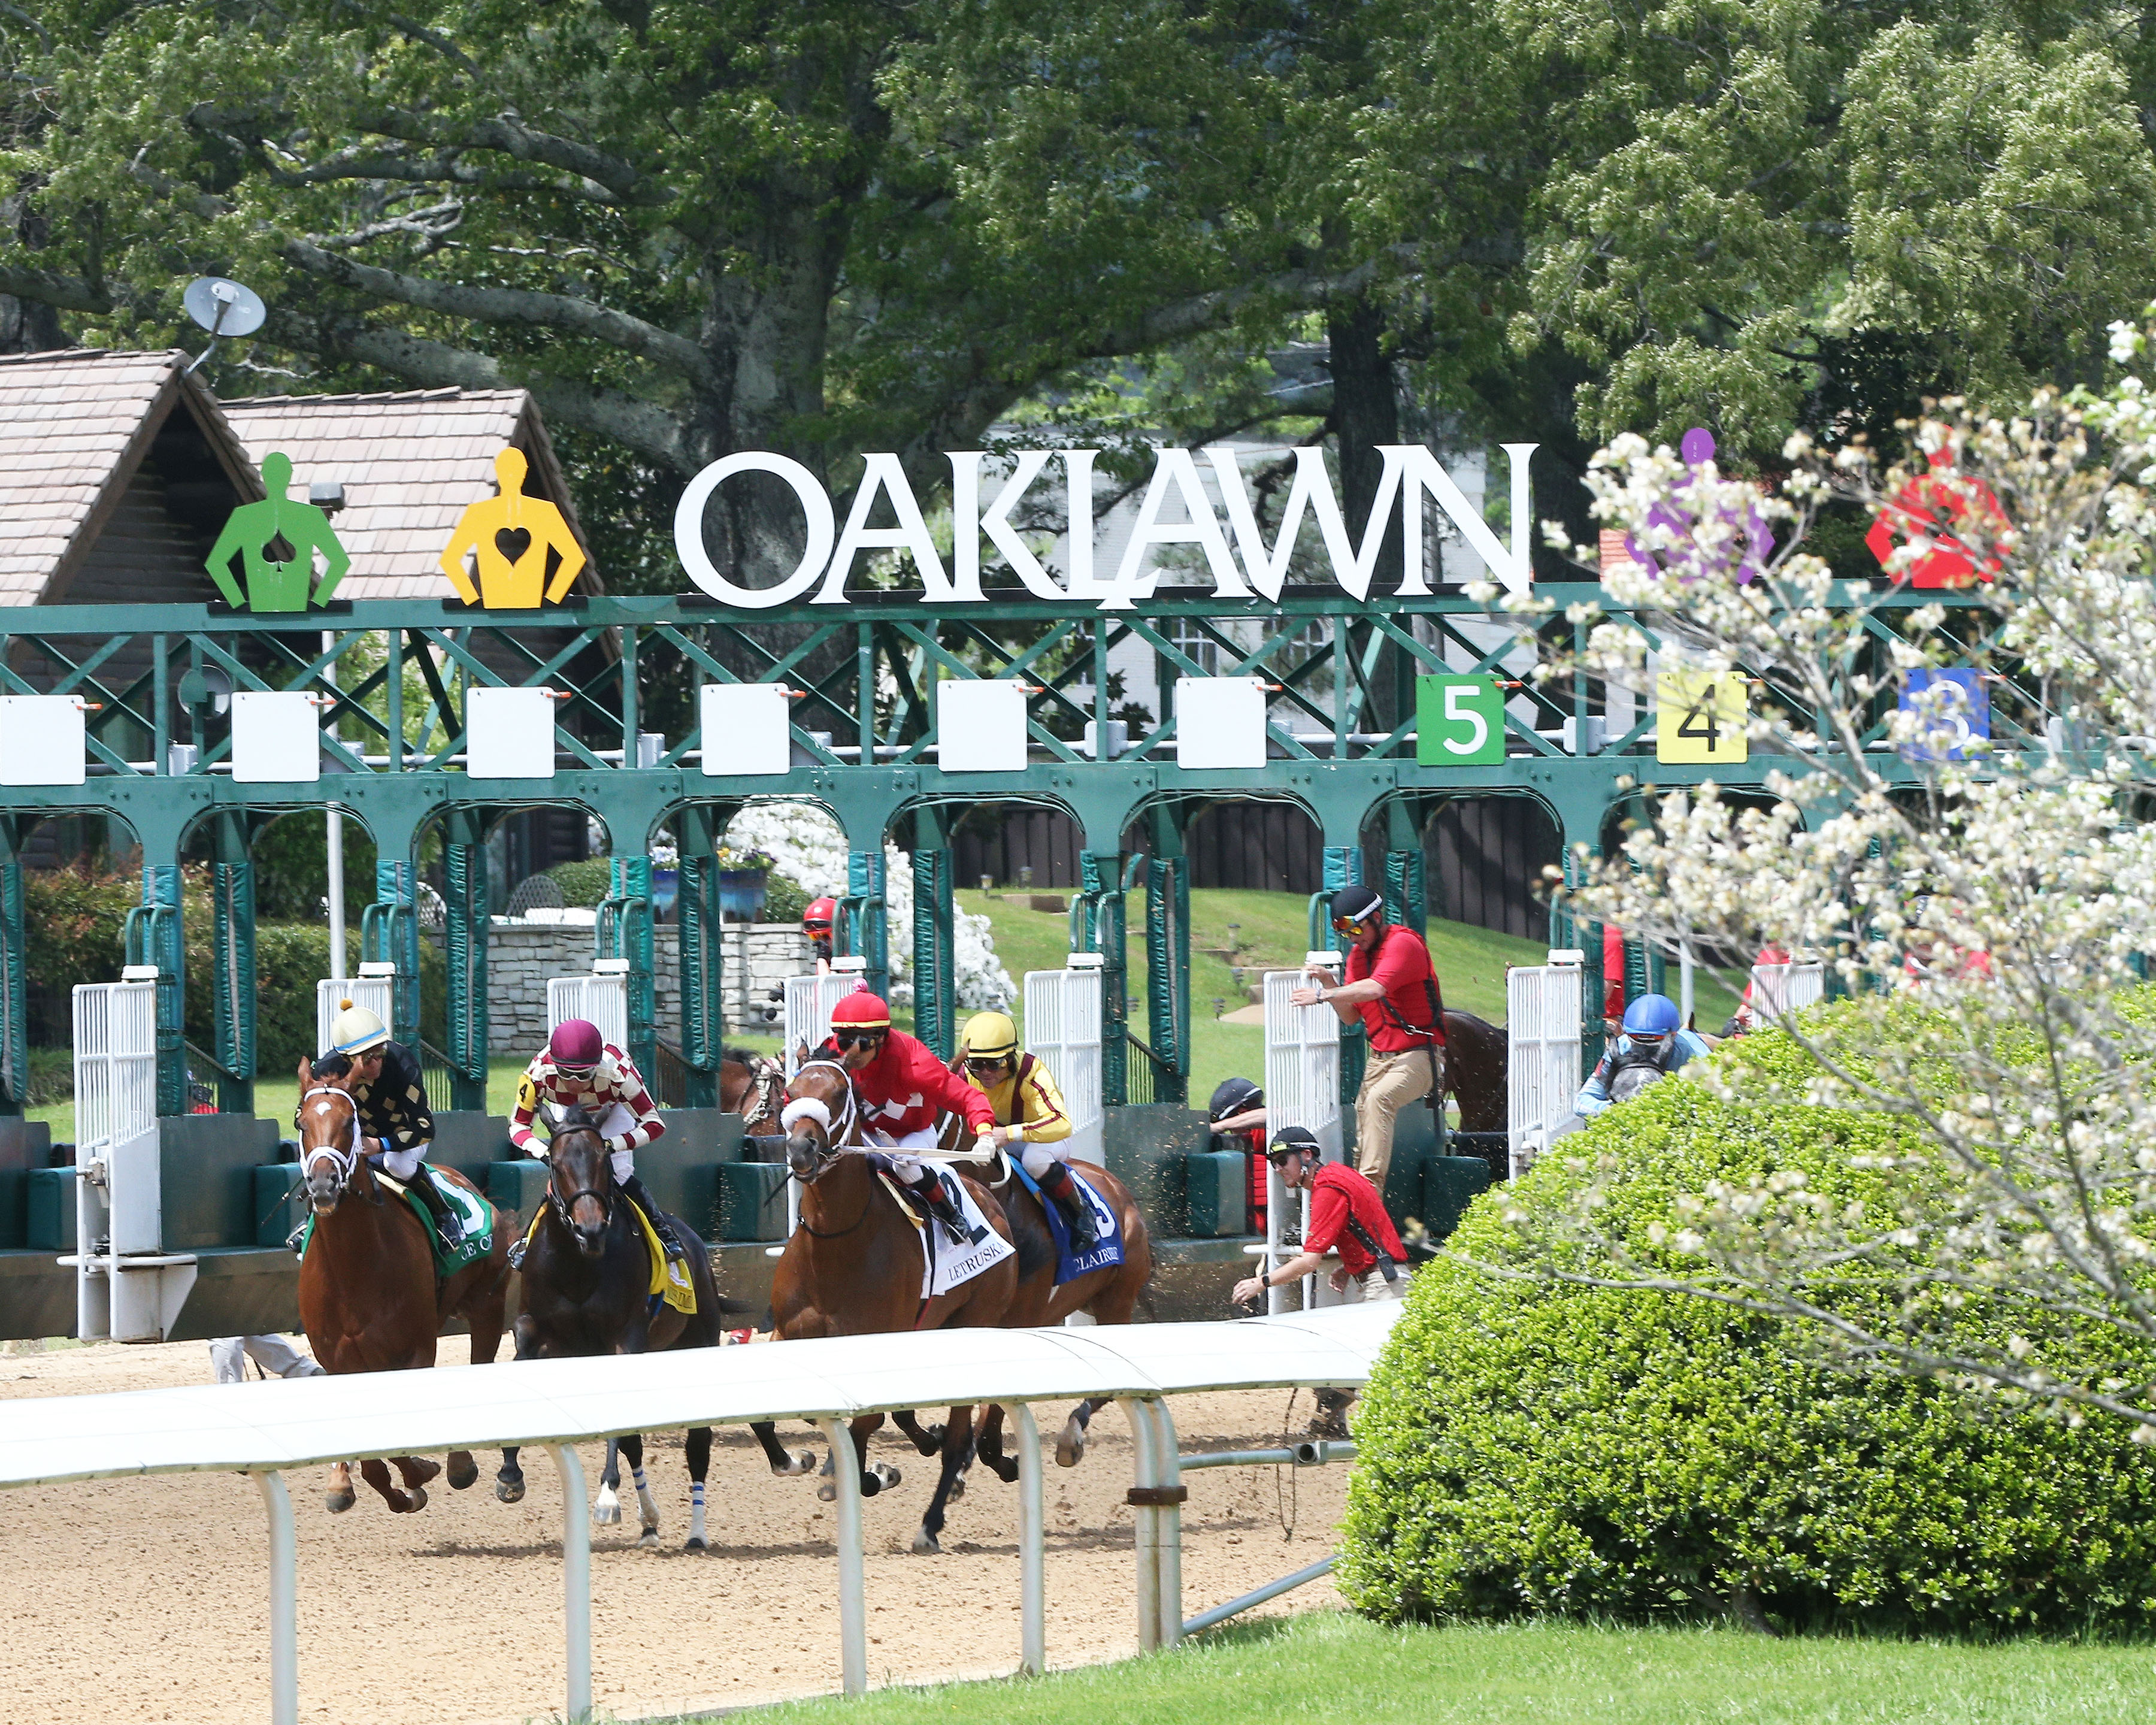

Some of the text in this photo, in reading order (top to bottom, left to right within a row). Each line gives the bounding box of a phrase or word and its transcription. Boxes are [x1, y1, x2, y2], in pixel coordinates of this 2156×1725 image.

[674, 443, 1540, 610] OAKLAWN
[1442, 685, 1488, 755] 5
[1678, 684, 1721, 752] 4
[1926, 679, 1970, 749] 3
